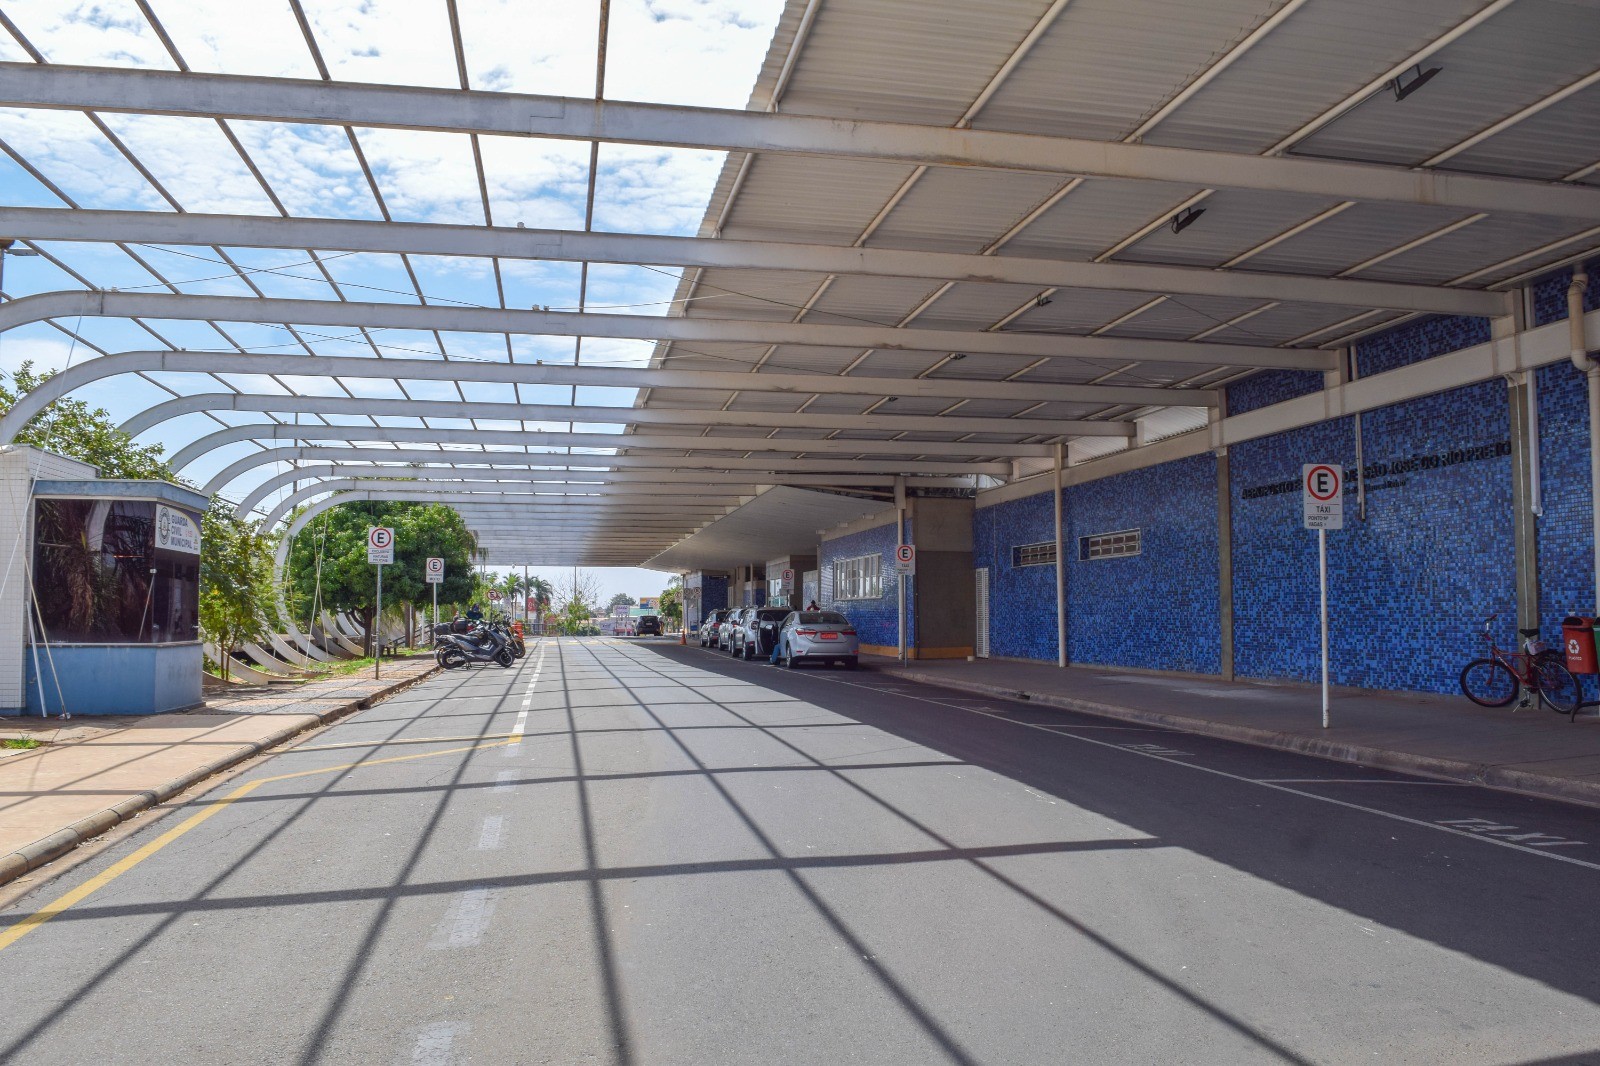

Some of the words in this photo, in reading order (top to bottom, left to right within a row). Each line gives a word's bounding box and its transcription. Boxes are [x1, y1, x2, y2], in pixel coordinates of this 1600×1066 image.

[1242, 480, 1293, 499] AEROPORTO
[1363, 461, 1387, 479] SÃO
[1389, 453, 1418, 475] JOSÉ
[1420, 454, 1440, 470] DO
[1440, 449, 1464, 467] RIO
[1465, 441, 1511, 463] PRETO
[1317, 473, 1328, 493] E
[1316, 504, 1331, 513] TÁXI
[172, 515, 188, 526] GUARDA
[172, 526, 182, 536] CIVIL
[171, 536, 192, 548] MUNICIPAL
[377, 532, 384, 544] E
[902, 549, 909, 559] E
[432, 561, 438, 570] E
[785, 571, 790, 579] E
[1434, 818, 1589, 847] TAXI
